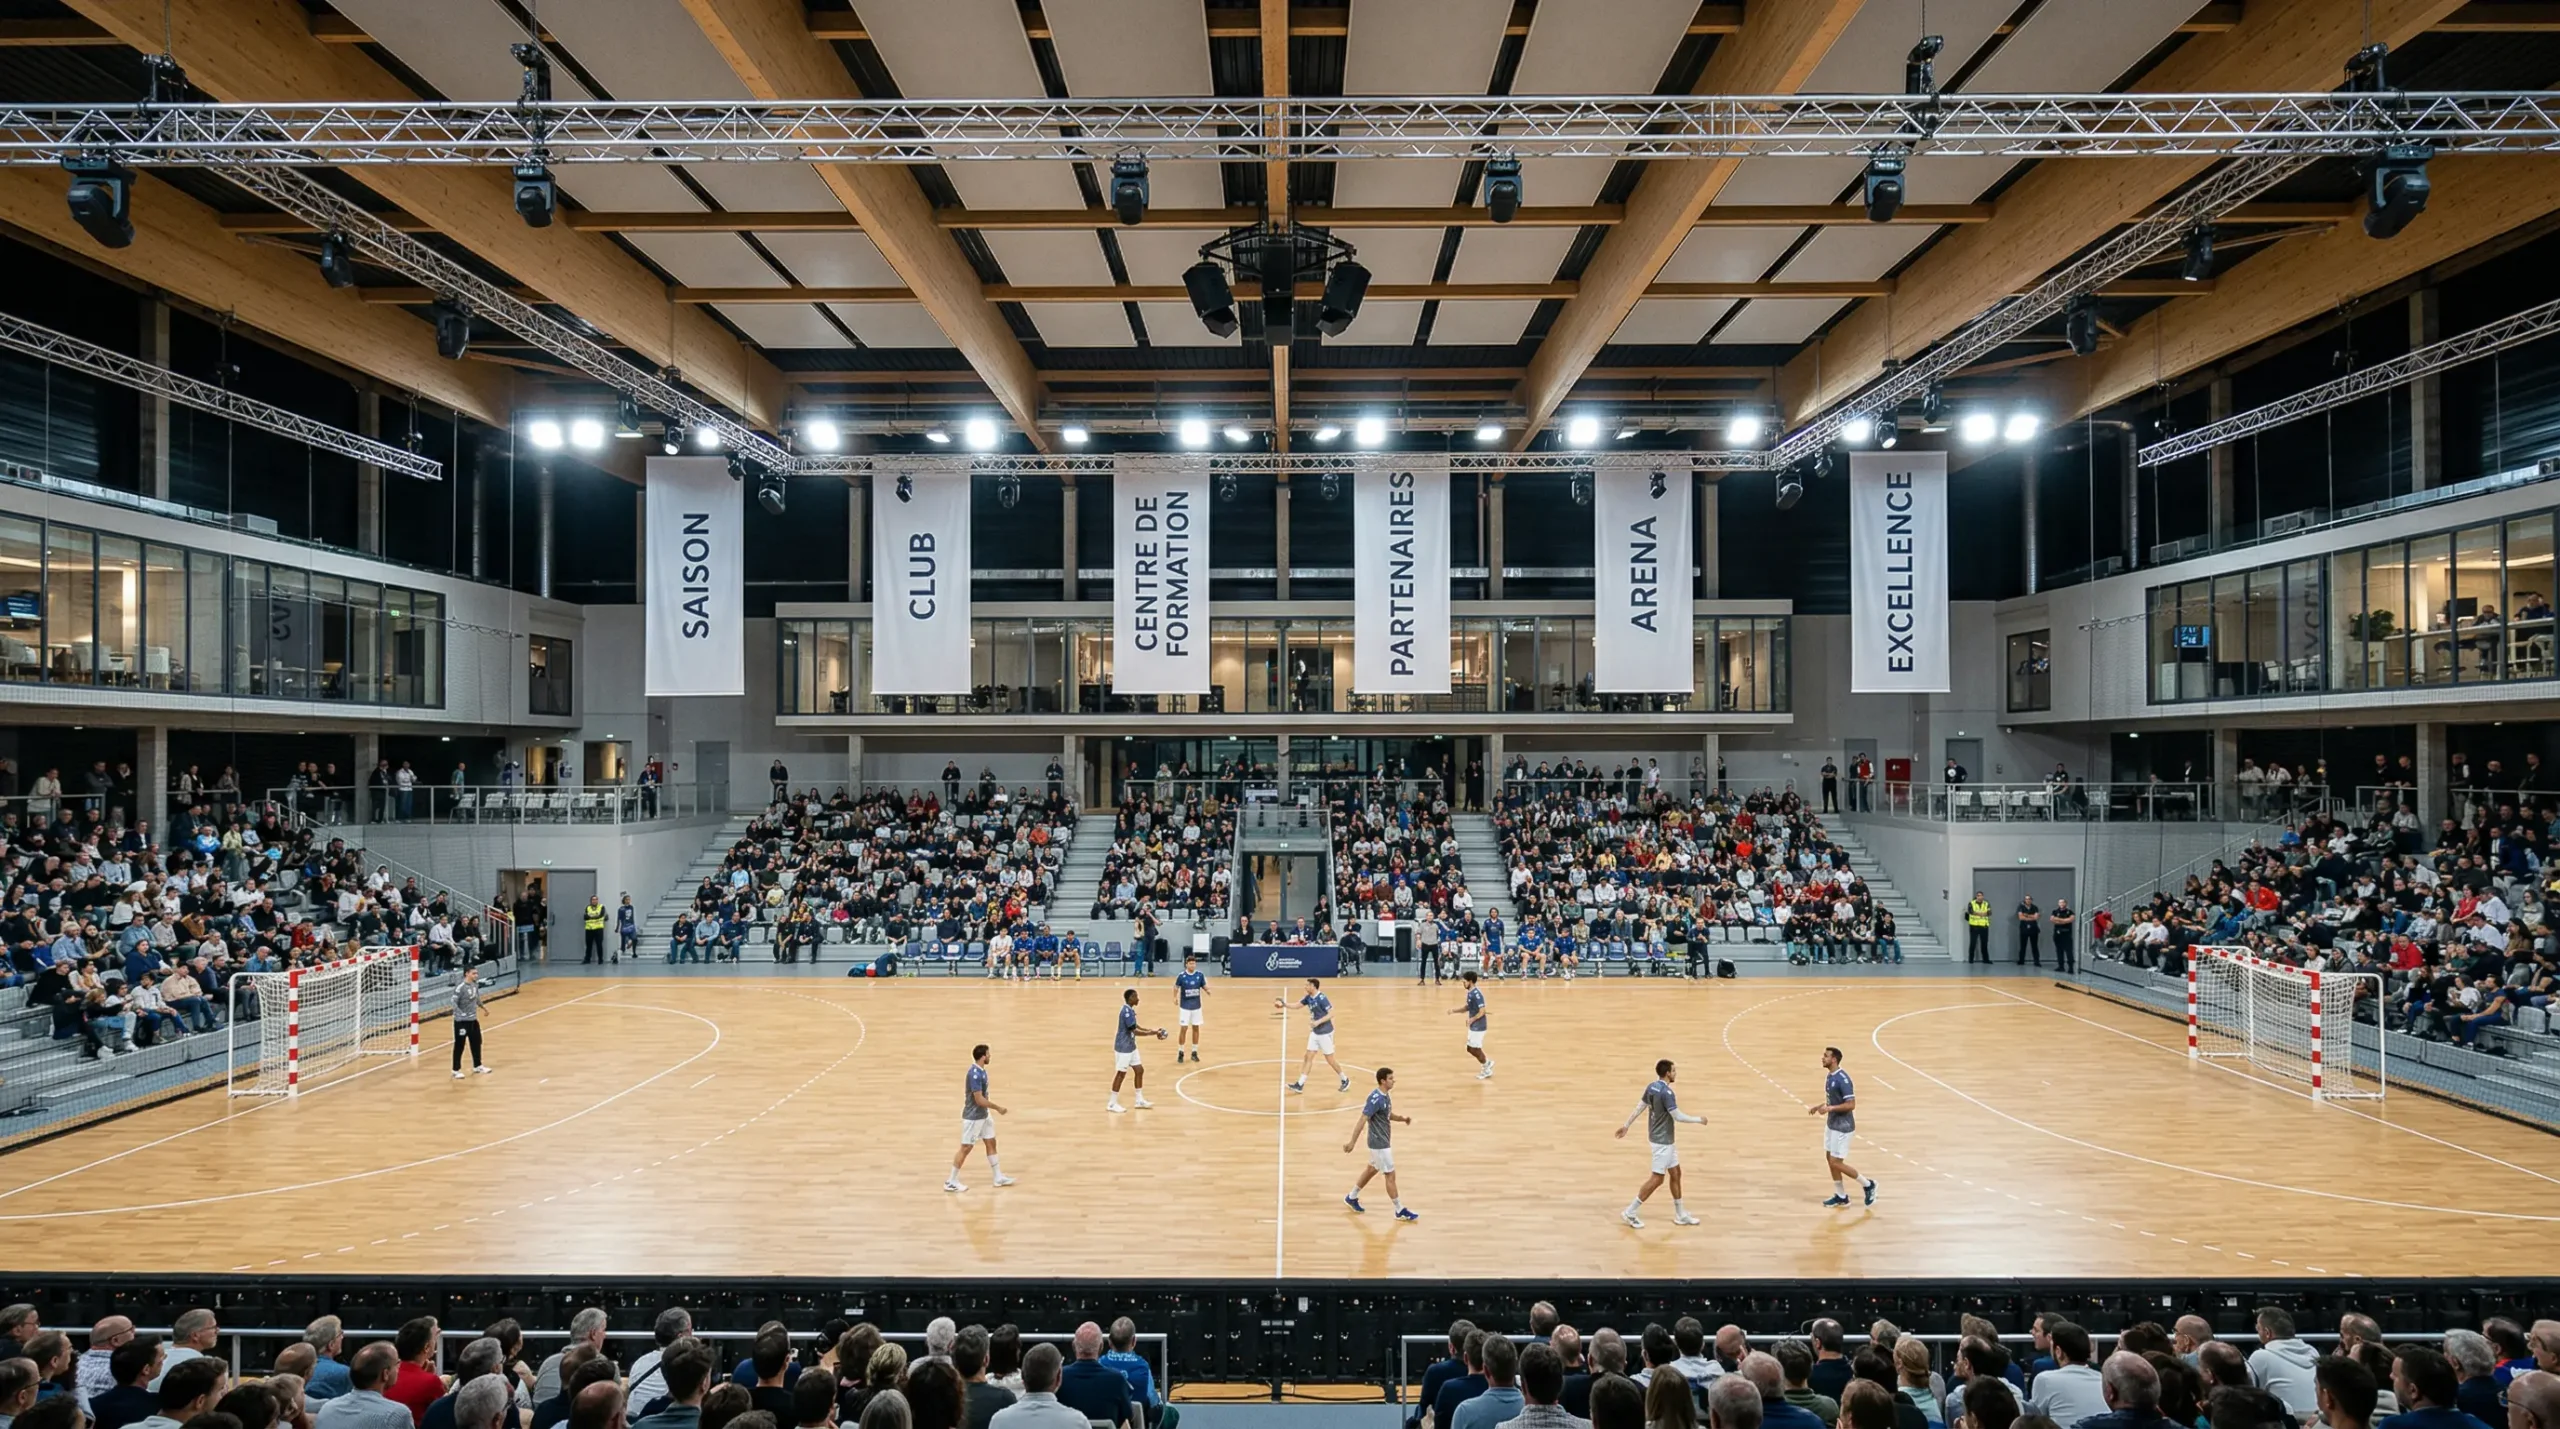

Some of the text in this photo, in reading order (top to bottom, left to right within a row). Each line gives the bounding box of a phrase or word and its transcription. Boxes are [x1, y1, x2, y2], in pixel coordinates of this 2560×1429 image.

[682, 514, 709, 638] SAISON
[909, 533, 935, 619] CLUB
[1135, 497, 1157, 650] CENTRE DE
[1166, 492, 1188, 656] FORMATION
[1389, 472, 1415, 675] PARTENAIRES
[1630, 516, 1657, 633] ARENA
[1887, 472, 1913, 672] EXCELLENCE
